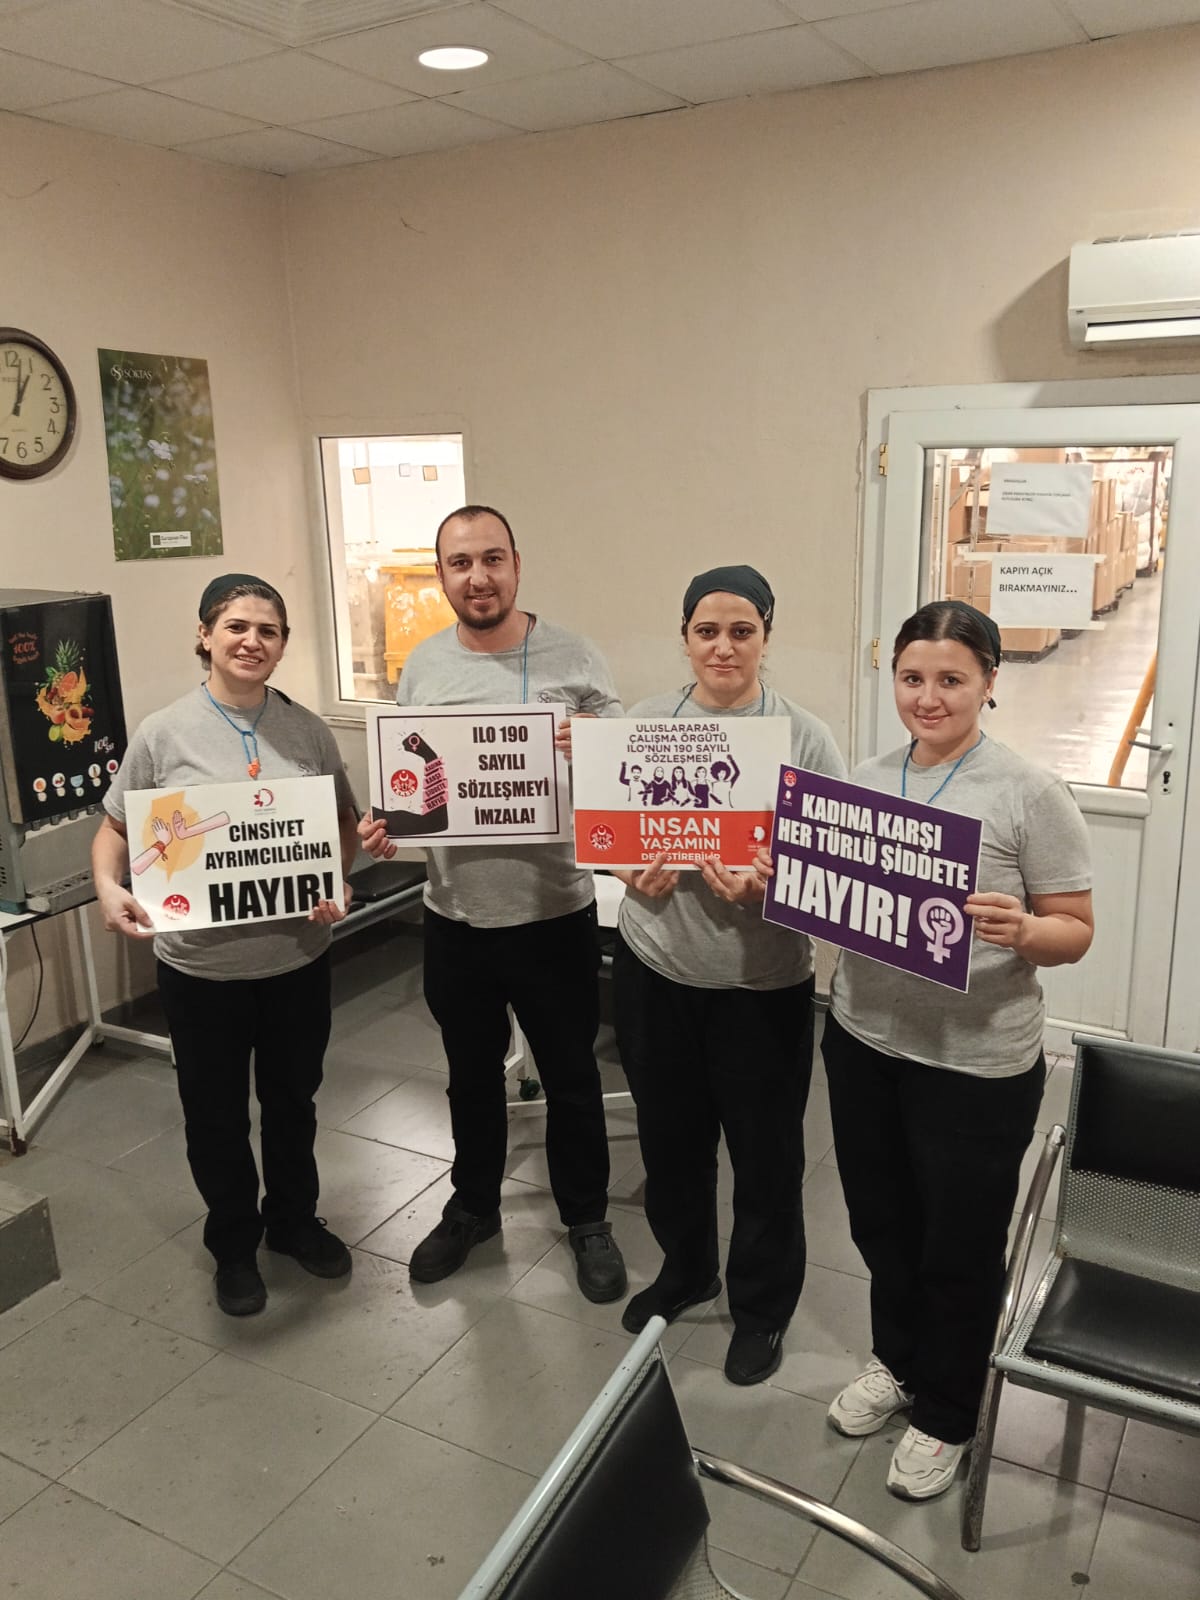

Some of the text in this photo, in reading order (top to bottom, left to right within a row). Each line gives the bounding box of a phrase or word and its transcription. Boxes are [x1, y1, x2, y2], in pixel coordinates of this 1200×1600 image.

[4, 350, 20, 368] 12
[40, 373, 52, 391] 2
[49, 397, 60, 414] 3
[47, 418, 57, 435] 4
[0, 437, 9, 454] 7
[16, 441, 28, 459] 6
[34, 436, 44, 454] 5
[1000, 566, 1053, 577] KAPIYI AÇIK
[999, 583, 1078, 593] BIRAKMAYINIZ...
[472, 725, 529, 744] ILO 190
[635, 723, 720, 733] ULUSLARARASI
[628, 732, 727, 744] ÇALIŞMA ÖRGÜTÜ
[627, 743, 730, 753] ILO'NUN 190 SAYILI
[478, 753, 526, 771] SAYILI
[644, 752, 713, 764] SÖZLEŞMESİ
[457, 777, 550, 800] SÖZLEŞMEYİ
[474, 806, 536, 826] İMZALA!
[639, 813, 721, 837] İNSAN
[801, 792, 943, 853] KADINA KARŞI
[228, 818, 305, 843] CİNSİYET
[640, 837, 721, 852] YAŞAMINI
[777, 816, 969, 891] HER TÜRLÜ ŞİDDETE
[205, 841, 333, 870] AYRIMCILIĞINA
[208, 872, 334, 923] HAYIR!
[773, 853, 912, 949] HAYIR!
